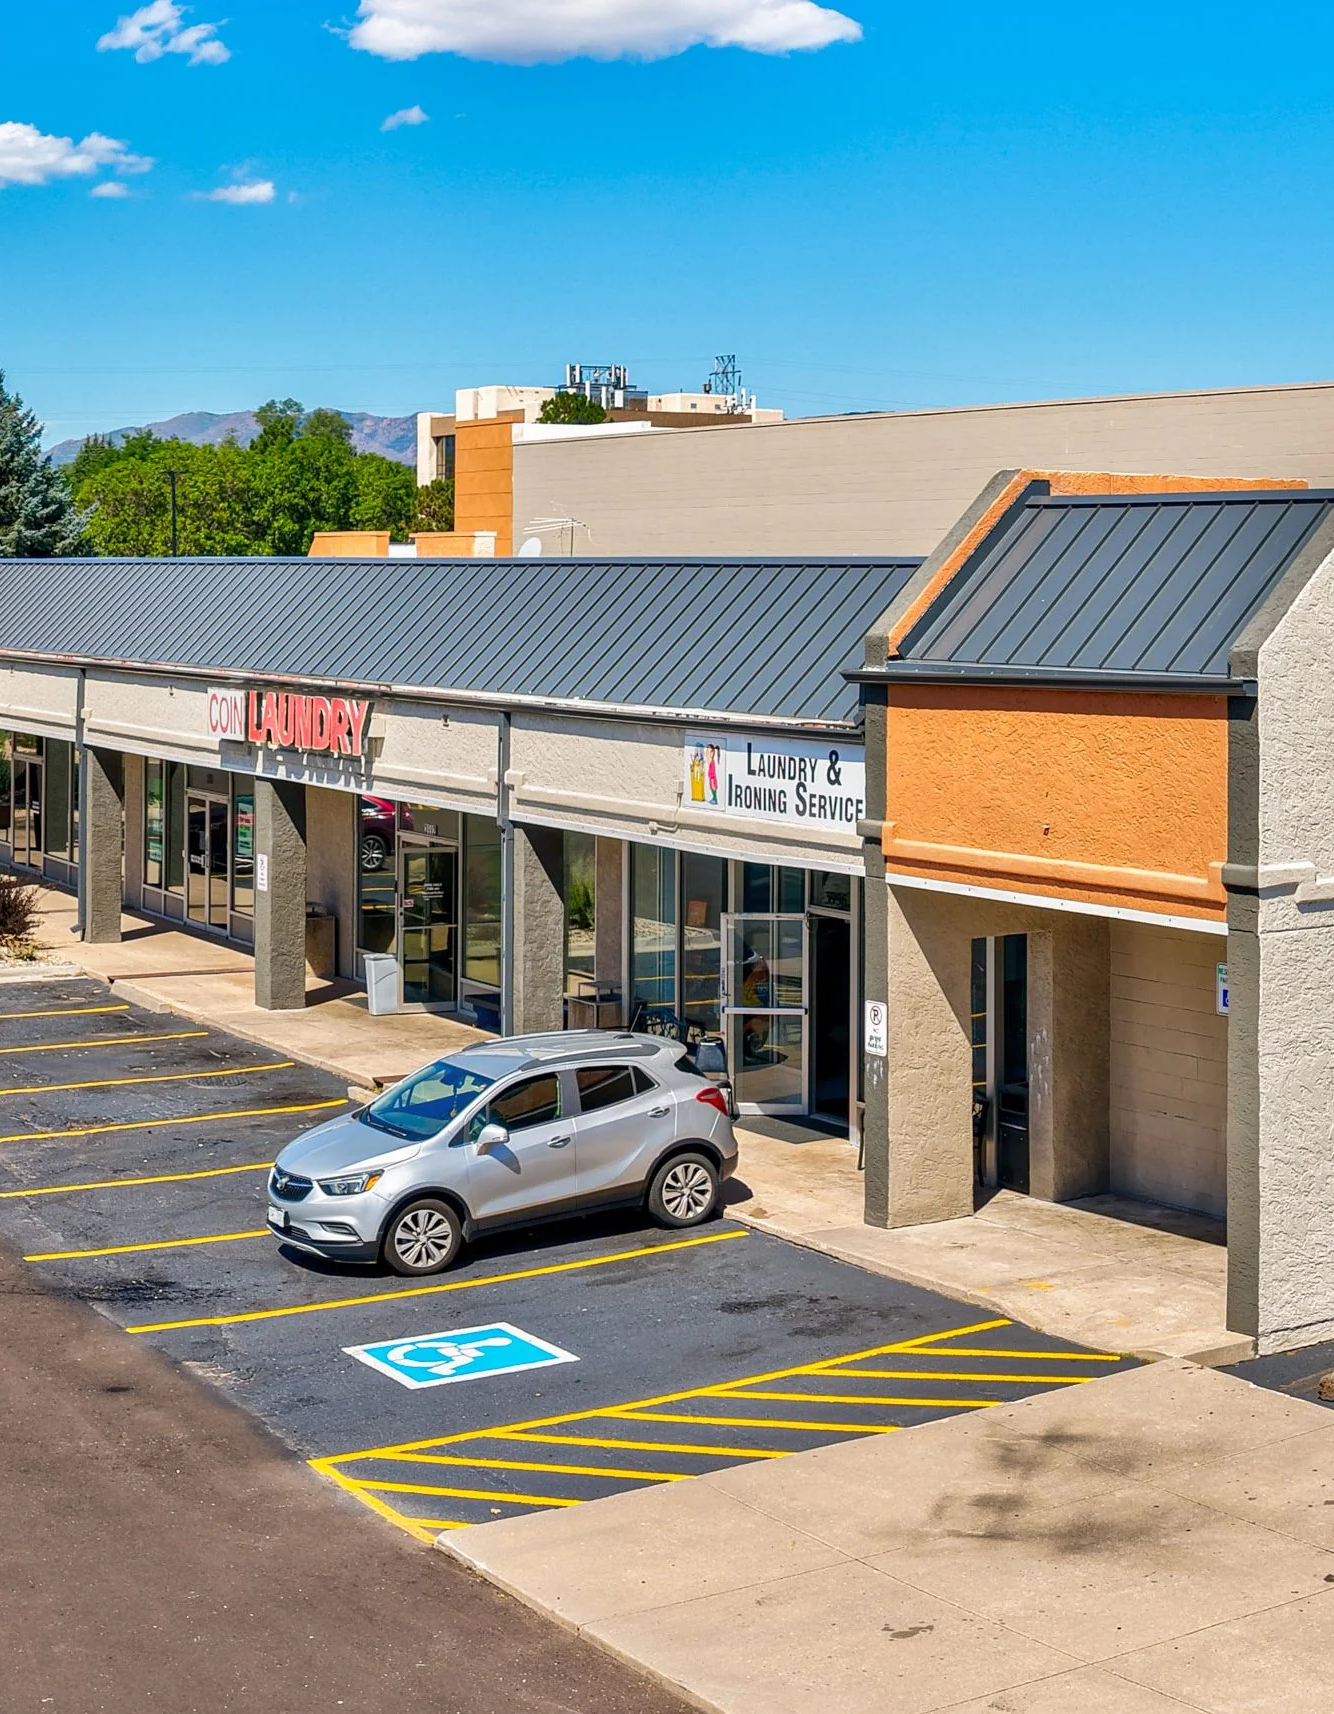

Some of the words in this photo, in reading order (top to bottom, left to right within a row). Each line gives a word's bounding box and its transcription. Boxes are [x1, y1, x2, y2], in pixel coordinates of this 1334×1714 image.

[209, 693, 244, 736] COIN
[248, 690, 369, 757] LAUNDRY
[747, 742, 818, 783] LAUNDRY
[826, 749, 843, 786] &
[728, 773, 787, 815] IRONING
[795, 781, 864, 823] SERVICE
